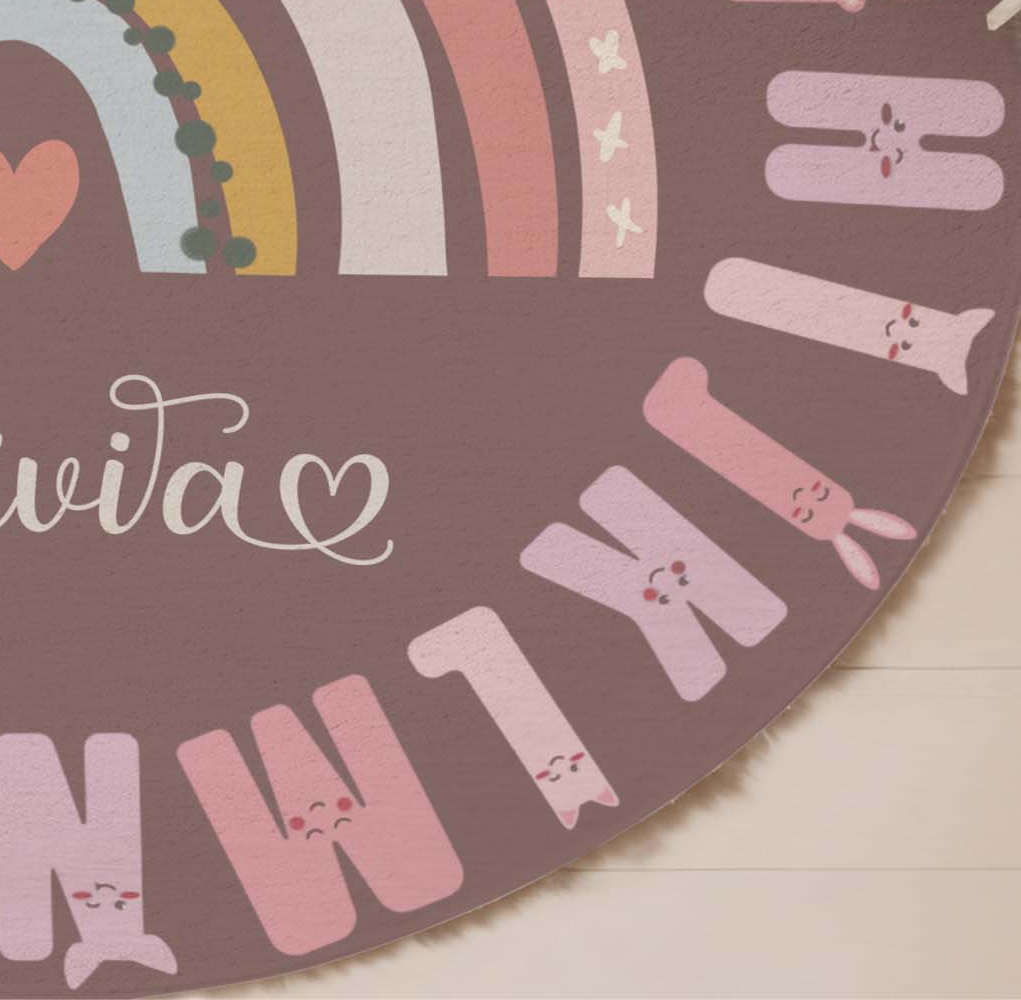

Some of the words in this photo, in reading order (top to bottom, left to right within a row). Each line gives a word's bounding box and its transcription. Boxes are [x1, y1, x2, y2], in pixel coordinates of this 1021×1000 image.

[765, 70, 1005, 211] H
[703, 257, 995, 395] I
[519, 465, 788, 702] K
[642, 357, 917, 591] J
[176, 674, 464, 956] M
[407, 606, 620, 830] L
